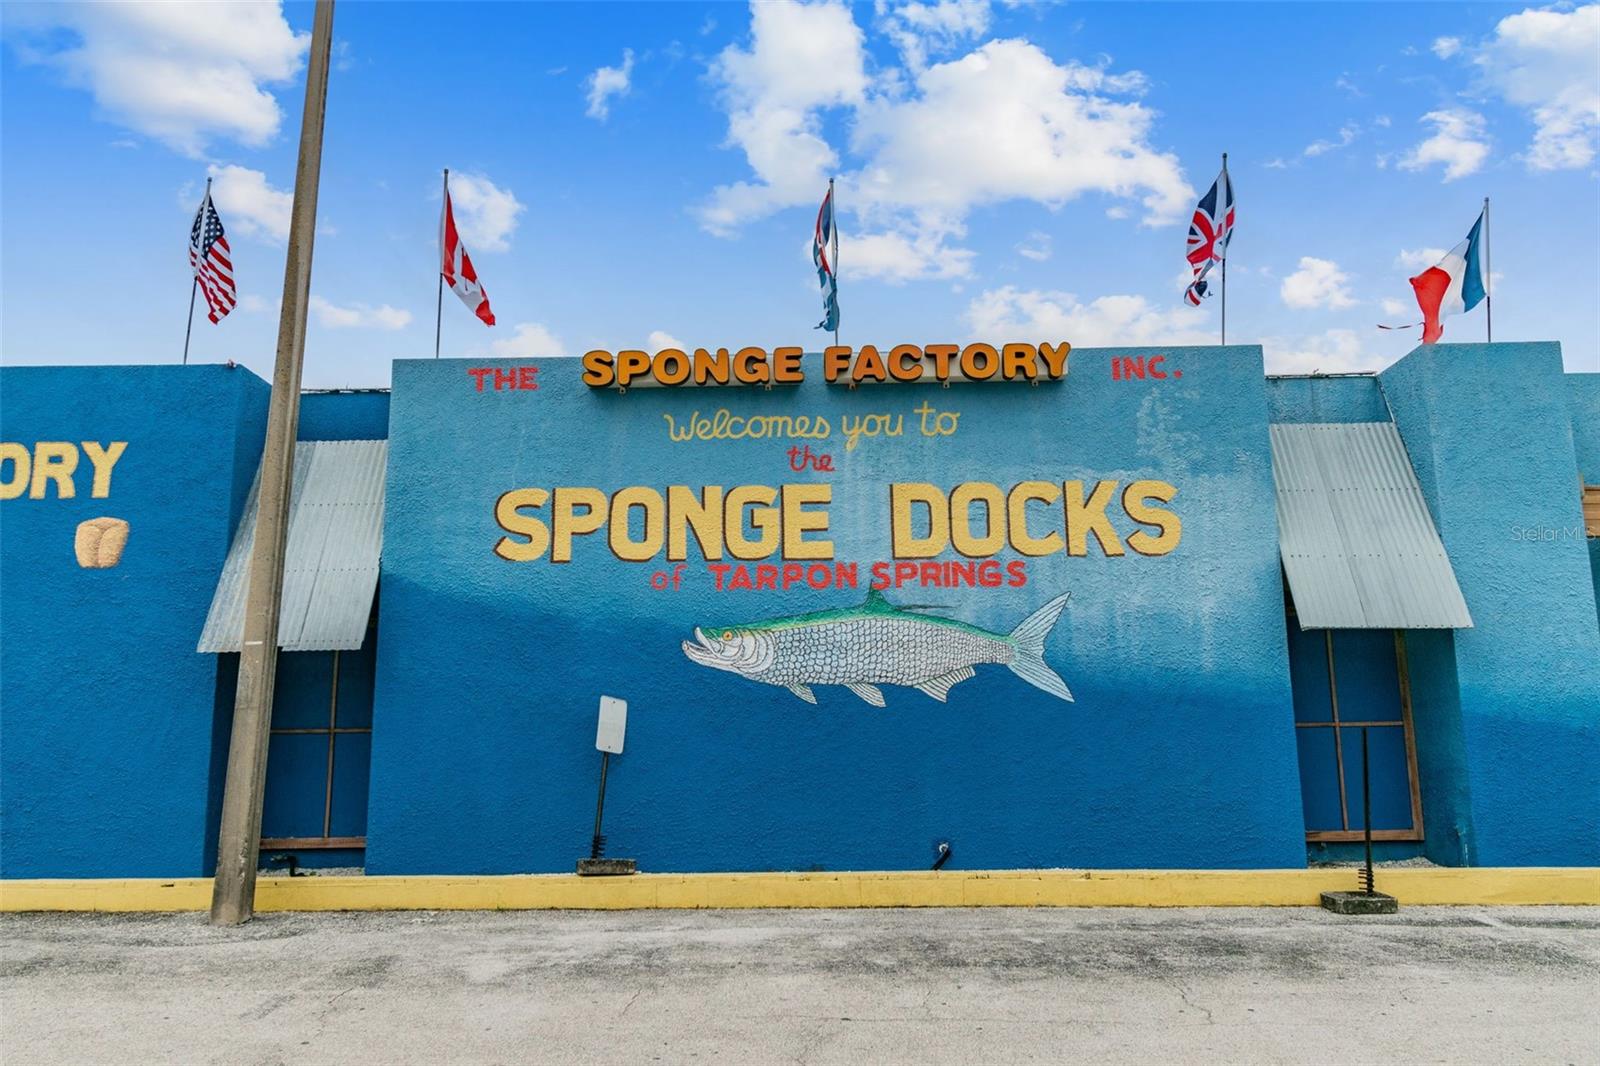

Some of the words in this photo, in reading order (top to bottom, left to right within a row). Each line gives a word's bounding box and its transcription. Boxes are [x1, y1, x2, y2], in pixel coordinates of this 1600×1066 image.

[468, 367, 539, 392] THE
[582, 347, 804, 387] SPONGE
[824, 342, 1071, 384] FACTORY
[1111, 355, 1183, 381] INC.
[664, 408, 831, 442] Welcomes
[841, 412, 903, 451] you
[914, 401, 961, 436] to
[787, 446, 835, 472] the
[493, 483, 835, 563] SPONGE
[889, 480, 1183, 560] DOCKS
[650, 566, 688, 591] of
[708, 562, 858, 591] TARPON
[871, 560, 1027, 590] SPRINGS
